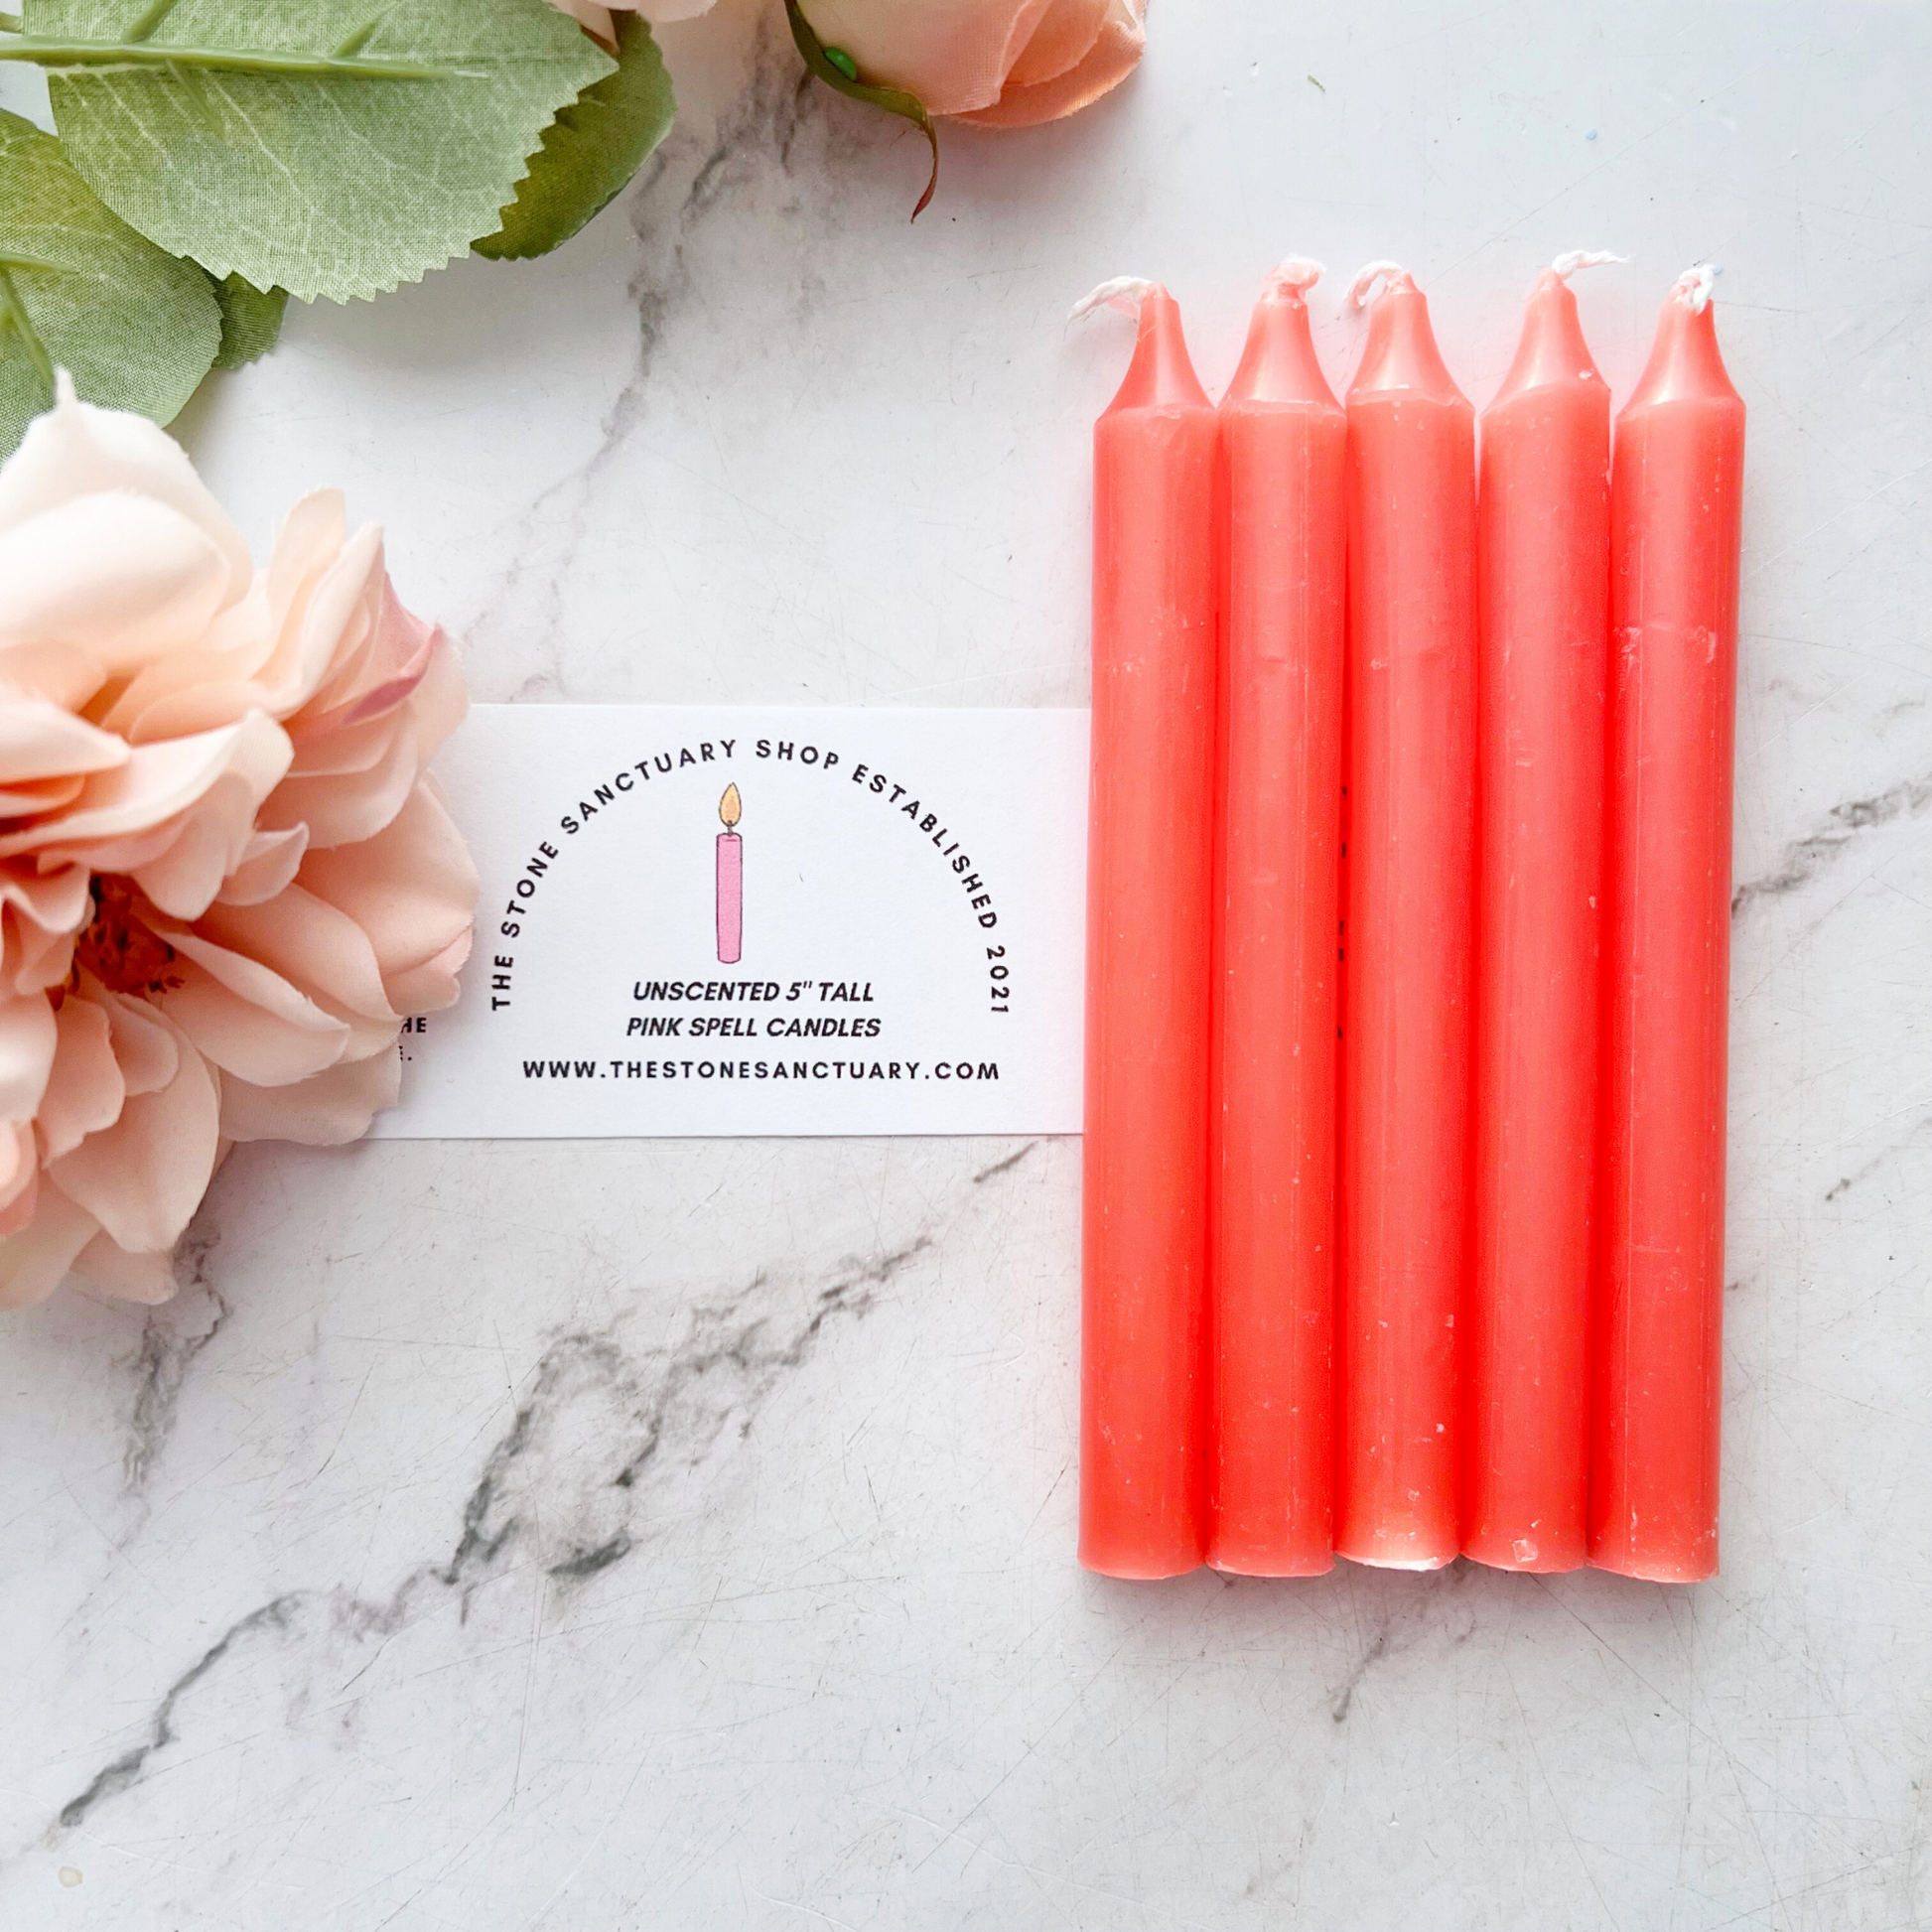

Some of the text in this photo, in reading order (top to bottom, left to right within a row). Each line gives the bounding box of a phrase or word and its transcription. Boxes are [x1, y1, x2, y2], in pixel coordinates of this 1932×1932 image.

[490, 739, 1010, 1013] THE STONE SANCTUARY SHOP ESTABLISHED 2021
[633, 981, 780, 1002] UNSCENTED
[818, 982, 874, 1002] TALL
[626, 1017, 882, 1037] PINK SPELL CANDLES
[522, 1060, 999, 1080] WWW.THESTONESANCTUARY.COM
